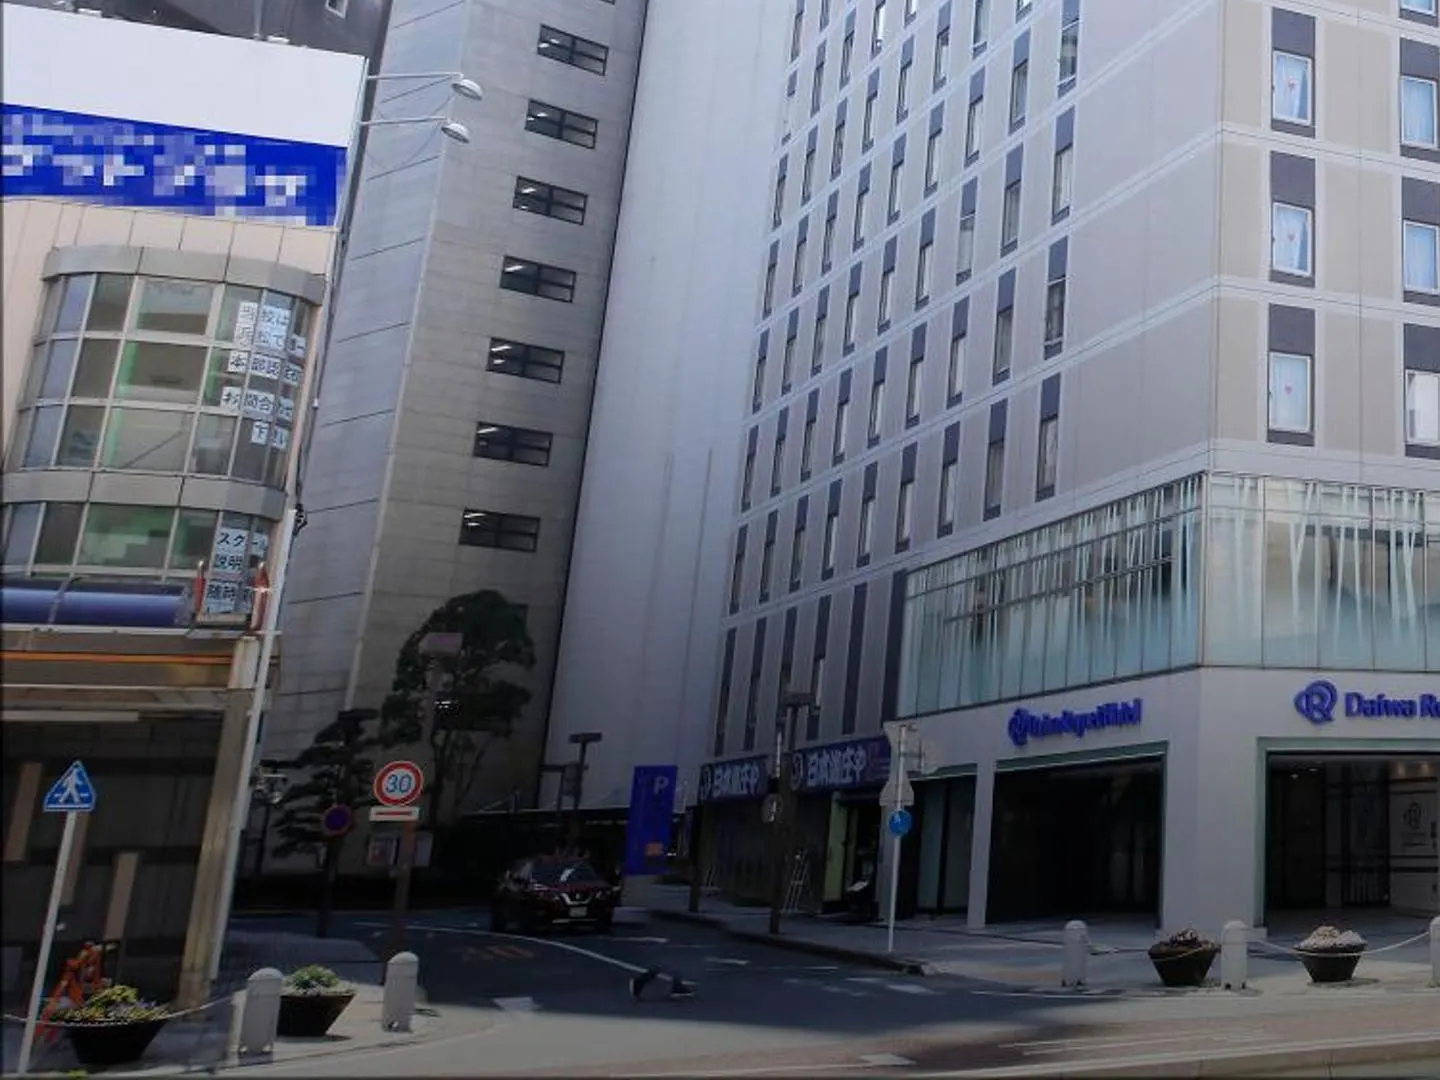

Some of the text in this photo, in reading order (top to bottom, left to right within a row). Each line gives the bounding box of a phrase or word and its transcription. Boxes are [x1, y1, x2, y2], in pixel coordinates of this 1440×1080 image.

[1345, 692, 1417, 718] Daiwa
[386, 774, 412, 793] 30
[653, 776, 669, 794] P
